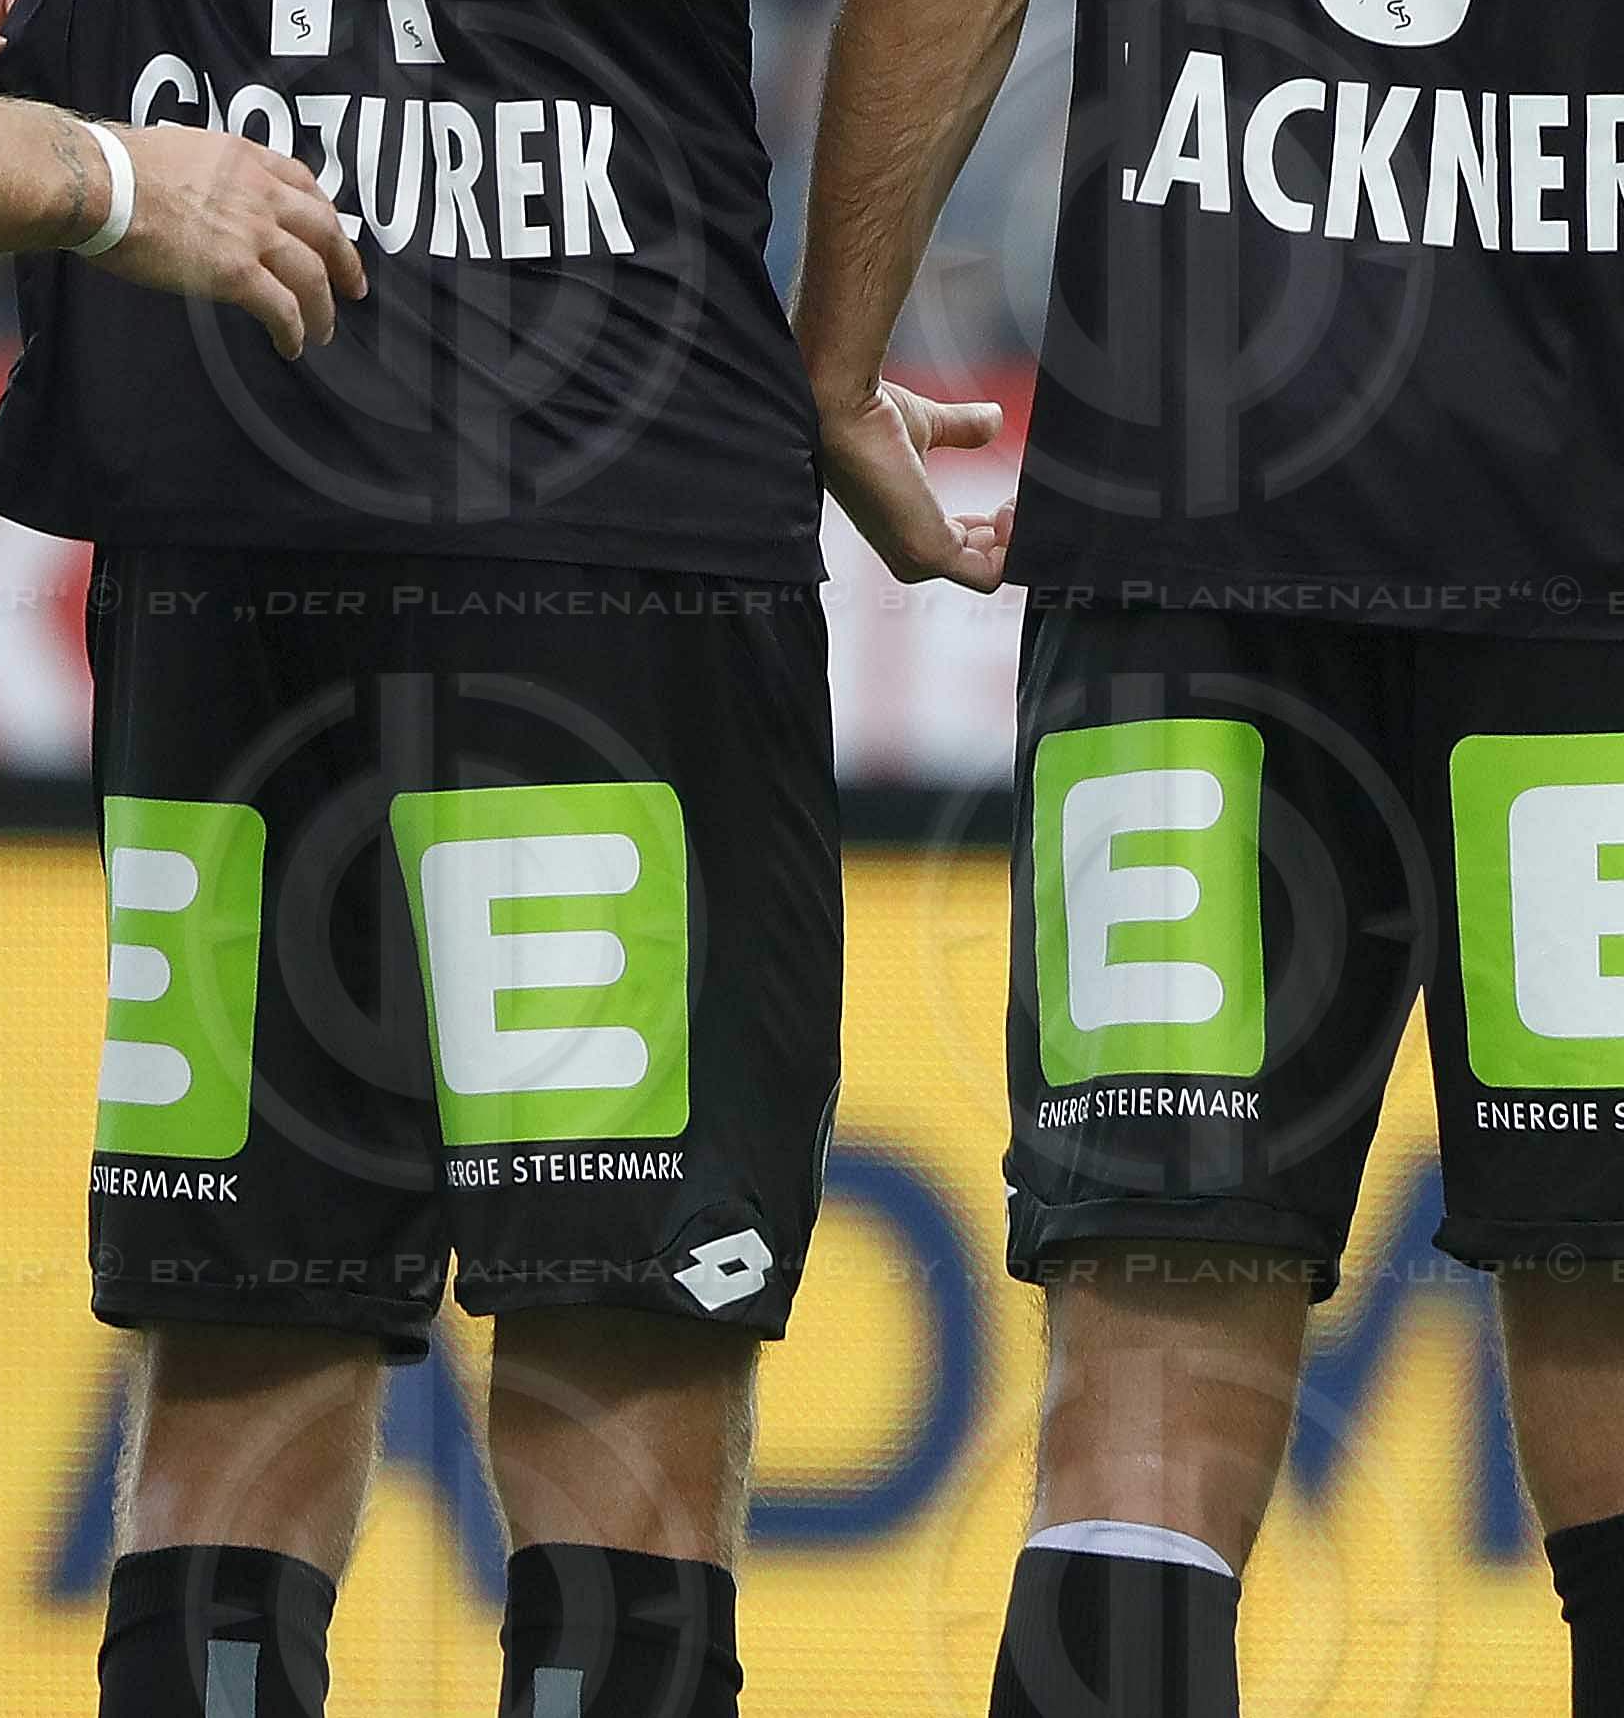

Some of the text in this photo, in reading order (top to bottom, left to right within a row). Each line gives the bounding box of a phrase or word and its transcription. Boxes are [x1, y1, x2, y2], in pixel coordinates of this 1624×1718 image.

[1062, 768, 1225, 1033] E
[419, 832, 649, 1096] E
[1096, 1087, 1261, 1120] STEIERMARK
[1476, 1099, 1598, 1132] ENERGIE
[447, 1151, 685, 1187] ERGIE STEIERMARK
